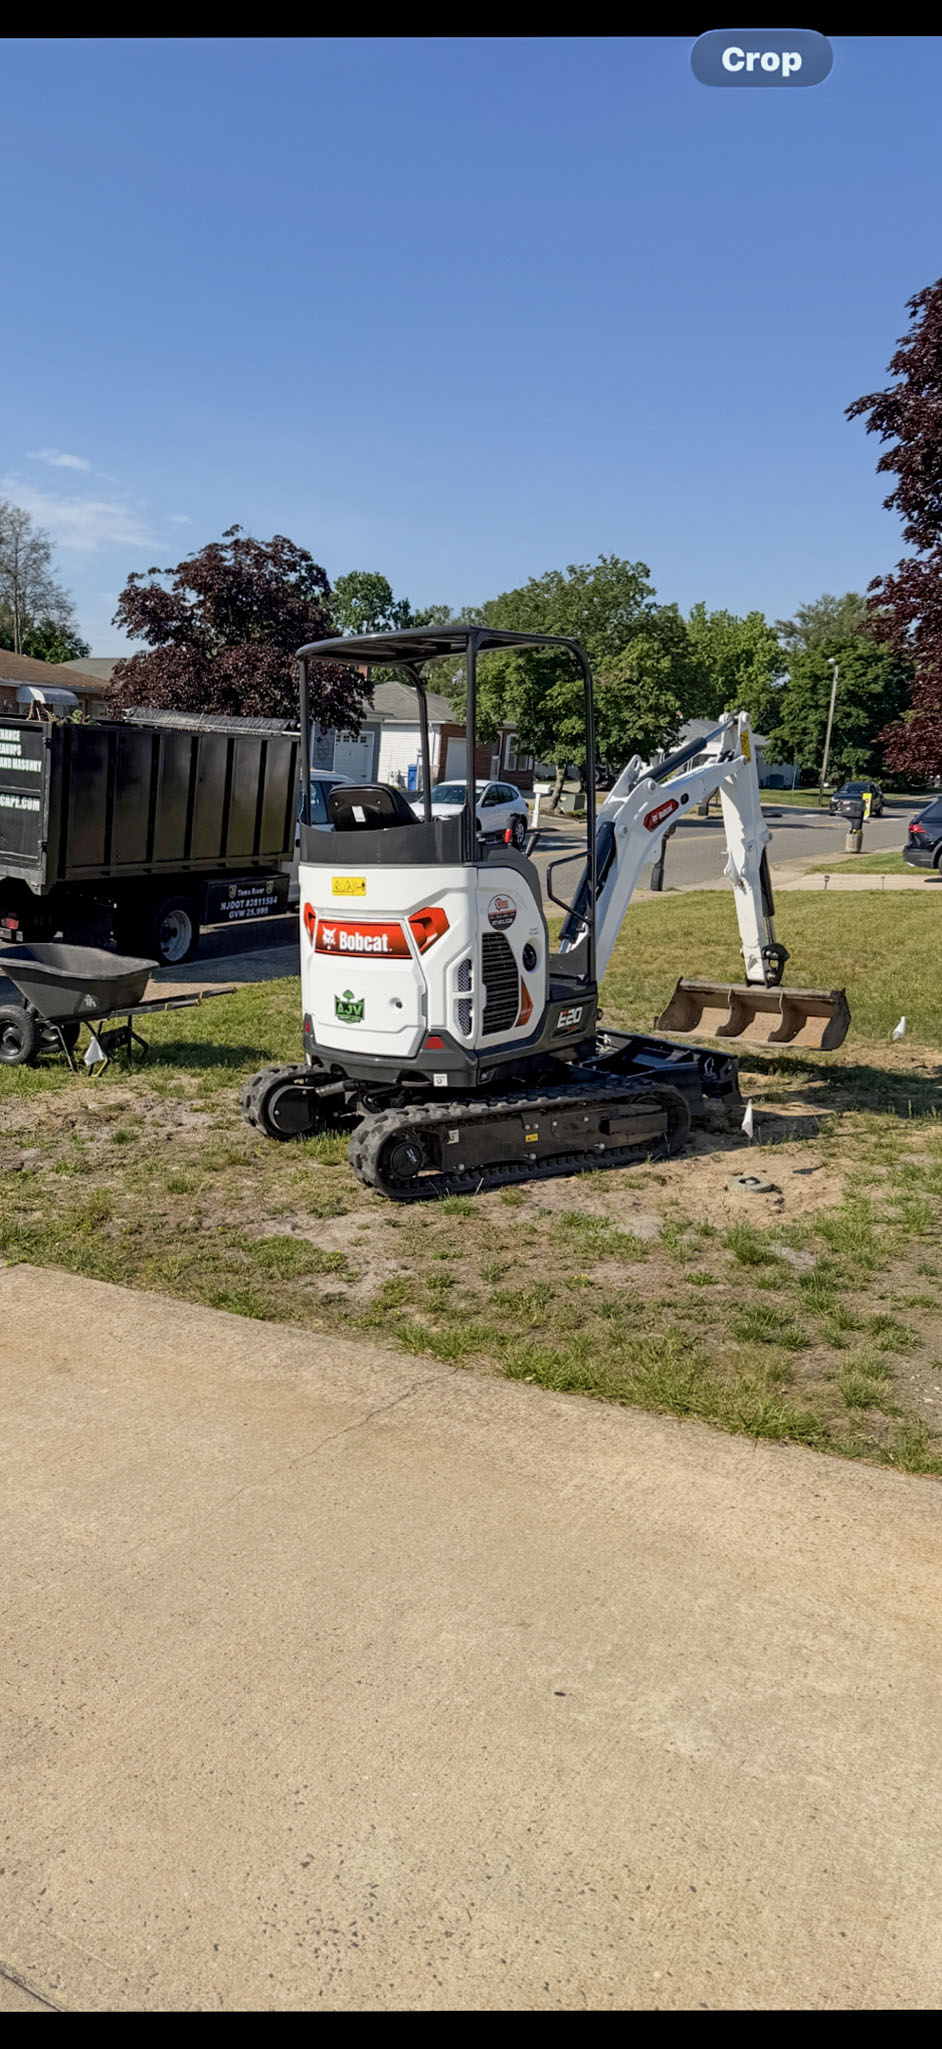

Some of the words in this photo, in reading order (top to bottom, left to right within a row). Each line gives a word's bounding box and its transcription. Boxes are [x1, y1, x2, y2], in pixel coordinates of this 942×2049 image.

[221, 900, 245, 910] NJDOT
[229, 909, 246, 918] GVW
[339, 931, 389, 952] Bobcat
[337, 1003, 362, 1016] AJV
[557, 1006, 583, 1028] E20
